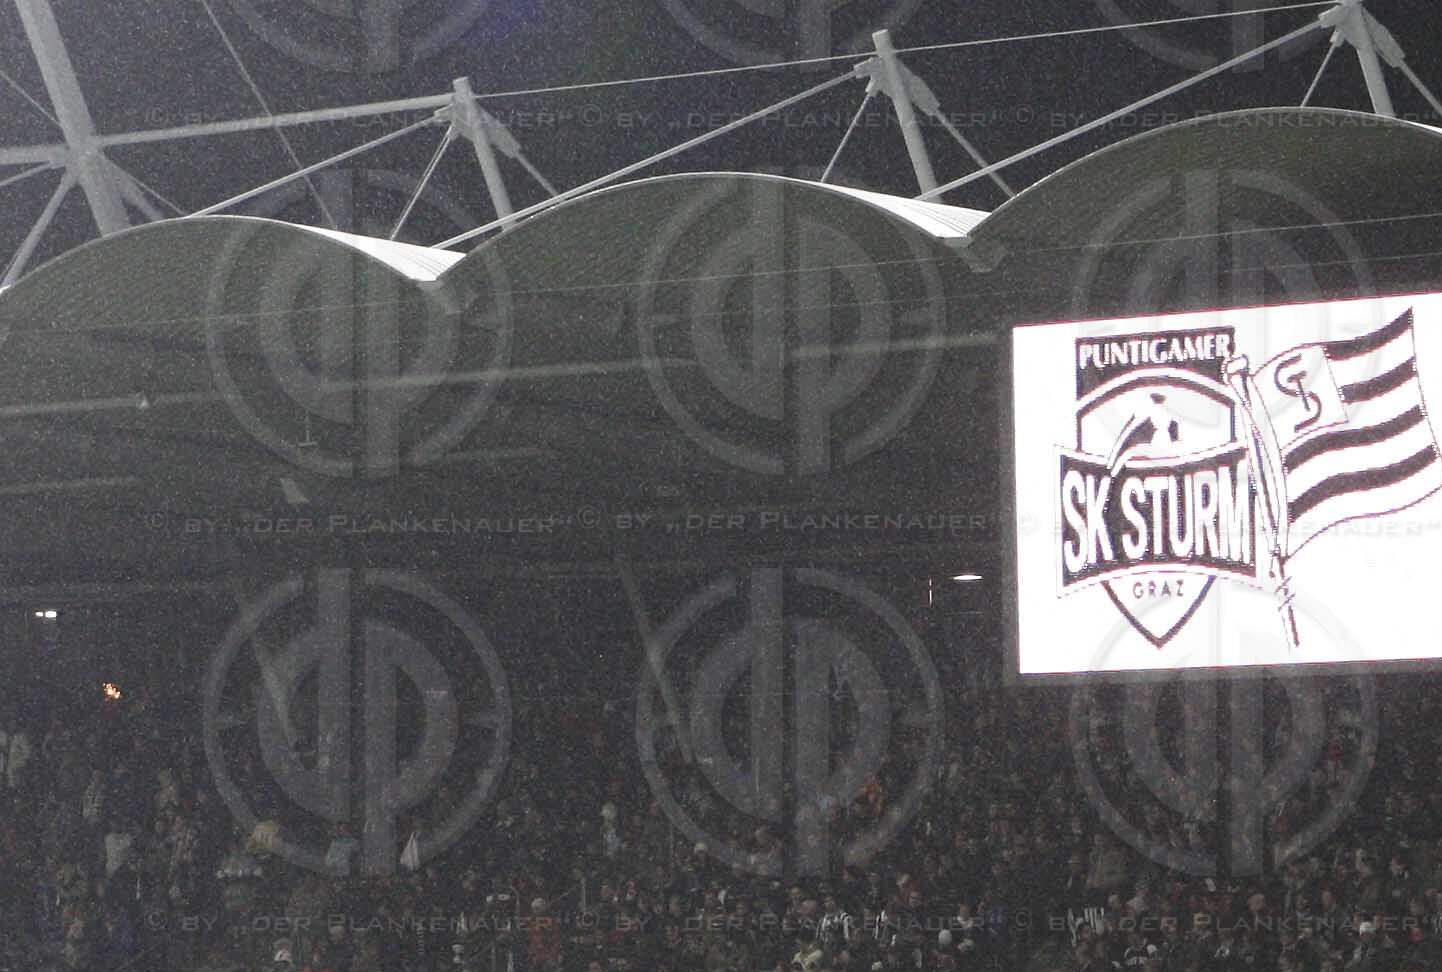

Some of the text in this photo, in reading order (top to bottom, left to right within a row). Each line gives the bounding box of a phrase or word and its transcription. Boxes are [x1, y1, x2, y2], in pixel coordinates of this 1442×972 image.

[1079, 333, 1230, 369] PUNTIGAMER
[1063, 458, 1255, 574] SK STURM
[1132, 579, 1185, 599] GRAZ
